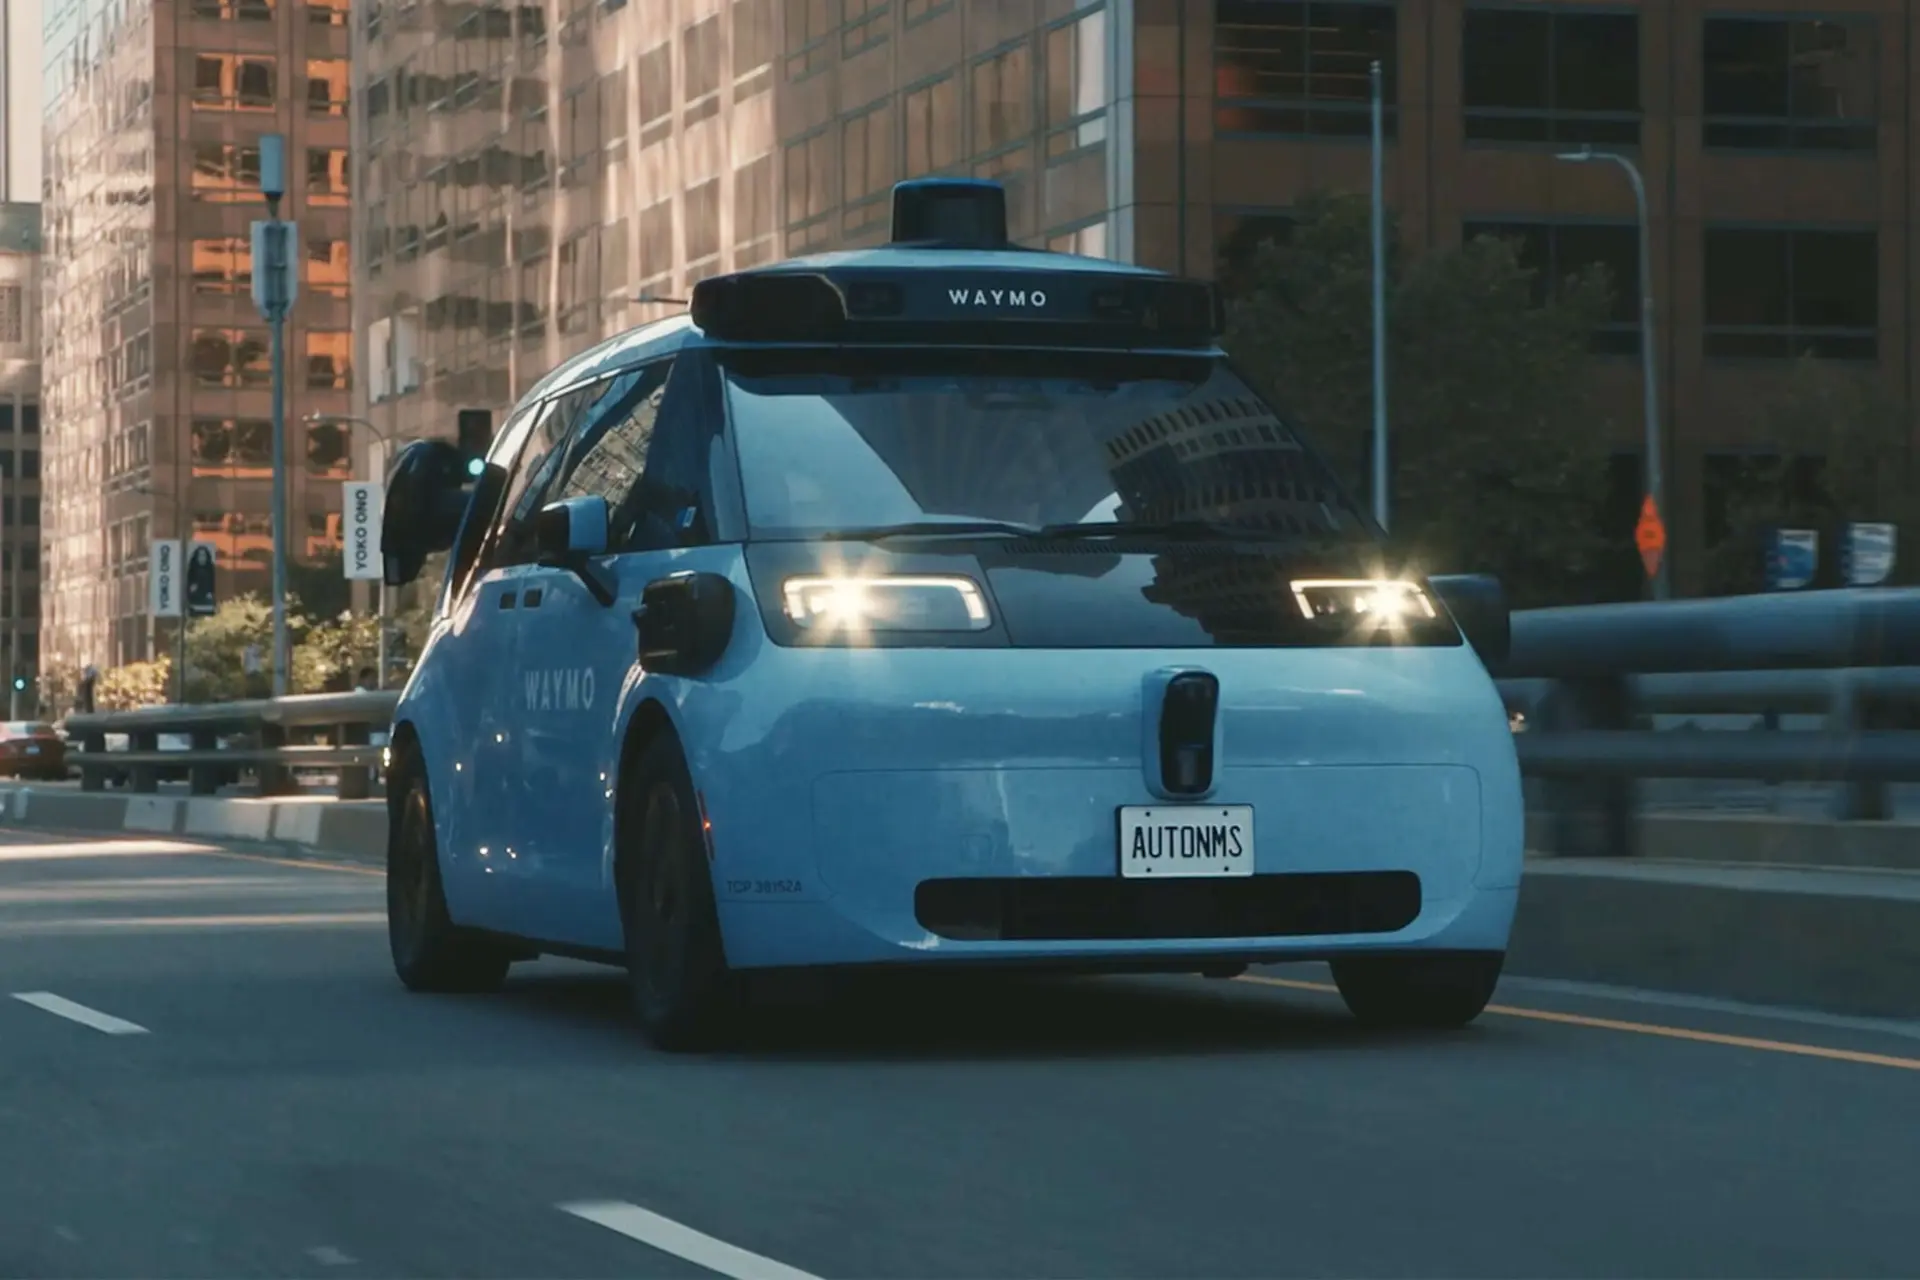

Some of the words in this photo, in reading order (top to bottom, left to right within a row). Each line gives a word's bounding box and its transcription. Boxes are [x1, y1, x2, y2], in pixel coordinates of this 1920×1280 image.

[948, 289, 1046, 307] WAYMO
[355, 489, 368, 524] ONO
[355, 527, 368, 571] YOKO
[525, 667, 595, 711] WAYMO
[1132, 825, 1243, 859] AUTONMS
[726, 879, 752, 894] TCP
